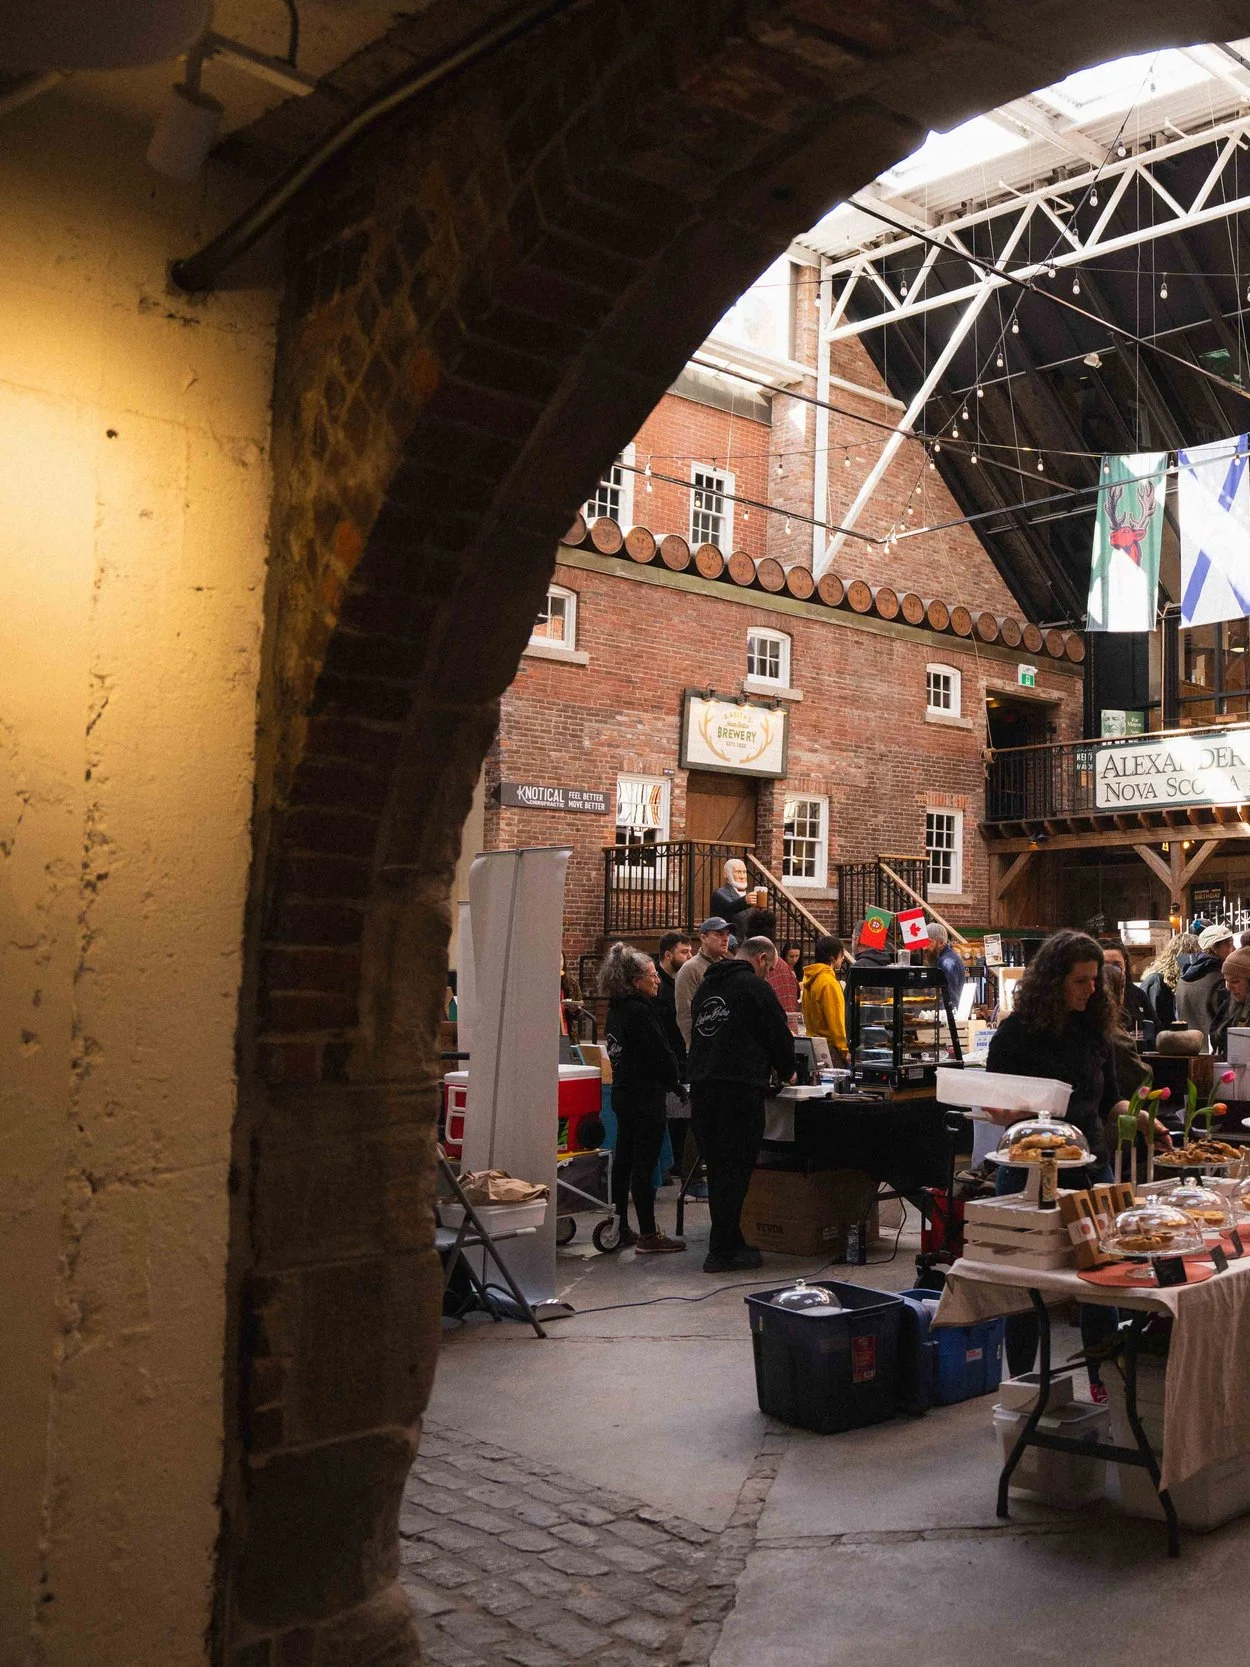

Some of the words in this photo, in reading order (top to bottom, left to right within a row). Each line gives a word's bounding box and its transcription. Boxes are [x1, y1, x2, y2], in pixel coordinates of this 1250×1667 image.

[718, 726, 756, 743] BREWERY
[1101, 746, 1245, 779] ALEXADER
[516, 785, 565, 803] KNOTICAL
[569, 791, 581, 800] FEEL
[583, 792, 603, 802] BETTER
[1105, 781, 1158, 802] NOVA
[1166, 774, 1240, 798] SCOA
[568, 800, 583, 809] MOVE
[585, 801, 605, 810] BETTER
[755, 1223, 784, 1235] VEVOR
